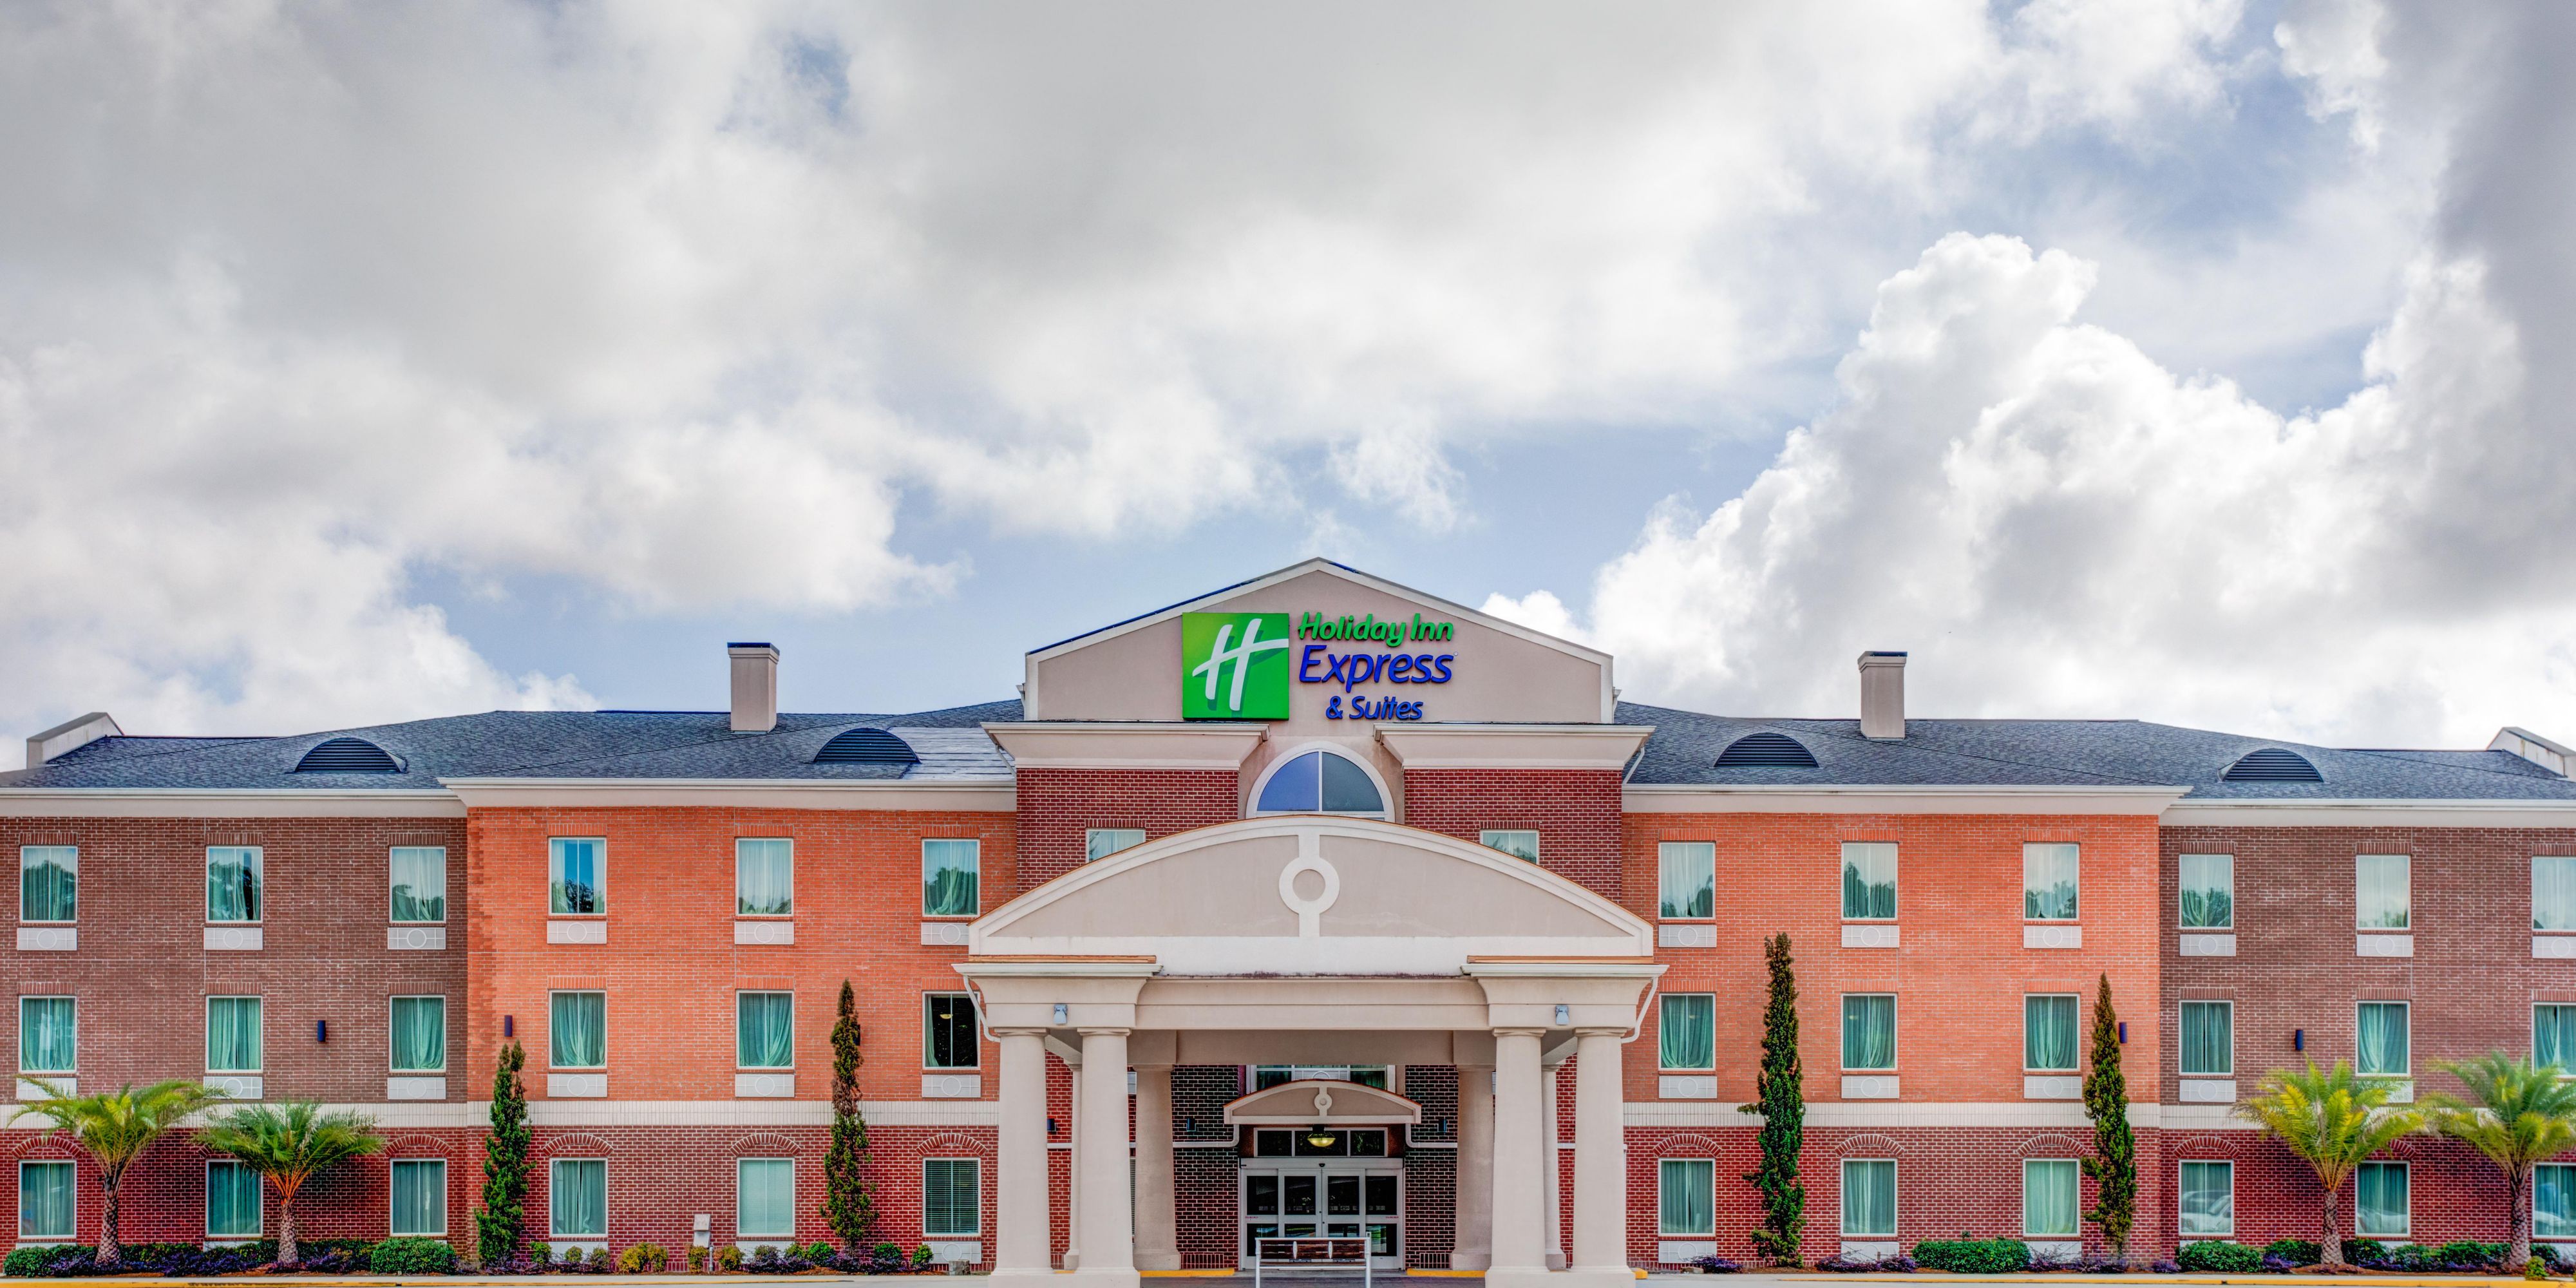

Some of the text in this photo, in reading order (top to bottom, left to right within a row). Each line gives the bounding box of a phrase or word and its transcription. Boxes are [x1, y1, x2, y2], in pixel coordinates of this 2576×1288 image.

[1298, 612, 1454, 647] Holiday Inn
[1192, 618, 1289, 711] H
[1299, 645, 1454, 693] Express
[1326, 696, 1423, 719] & Suites
